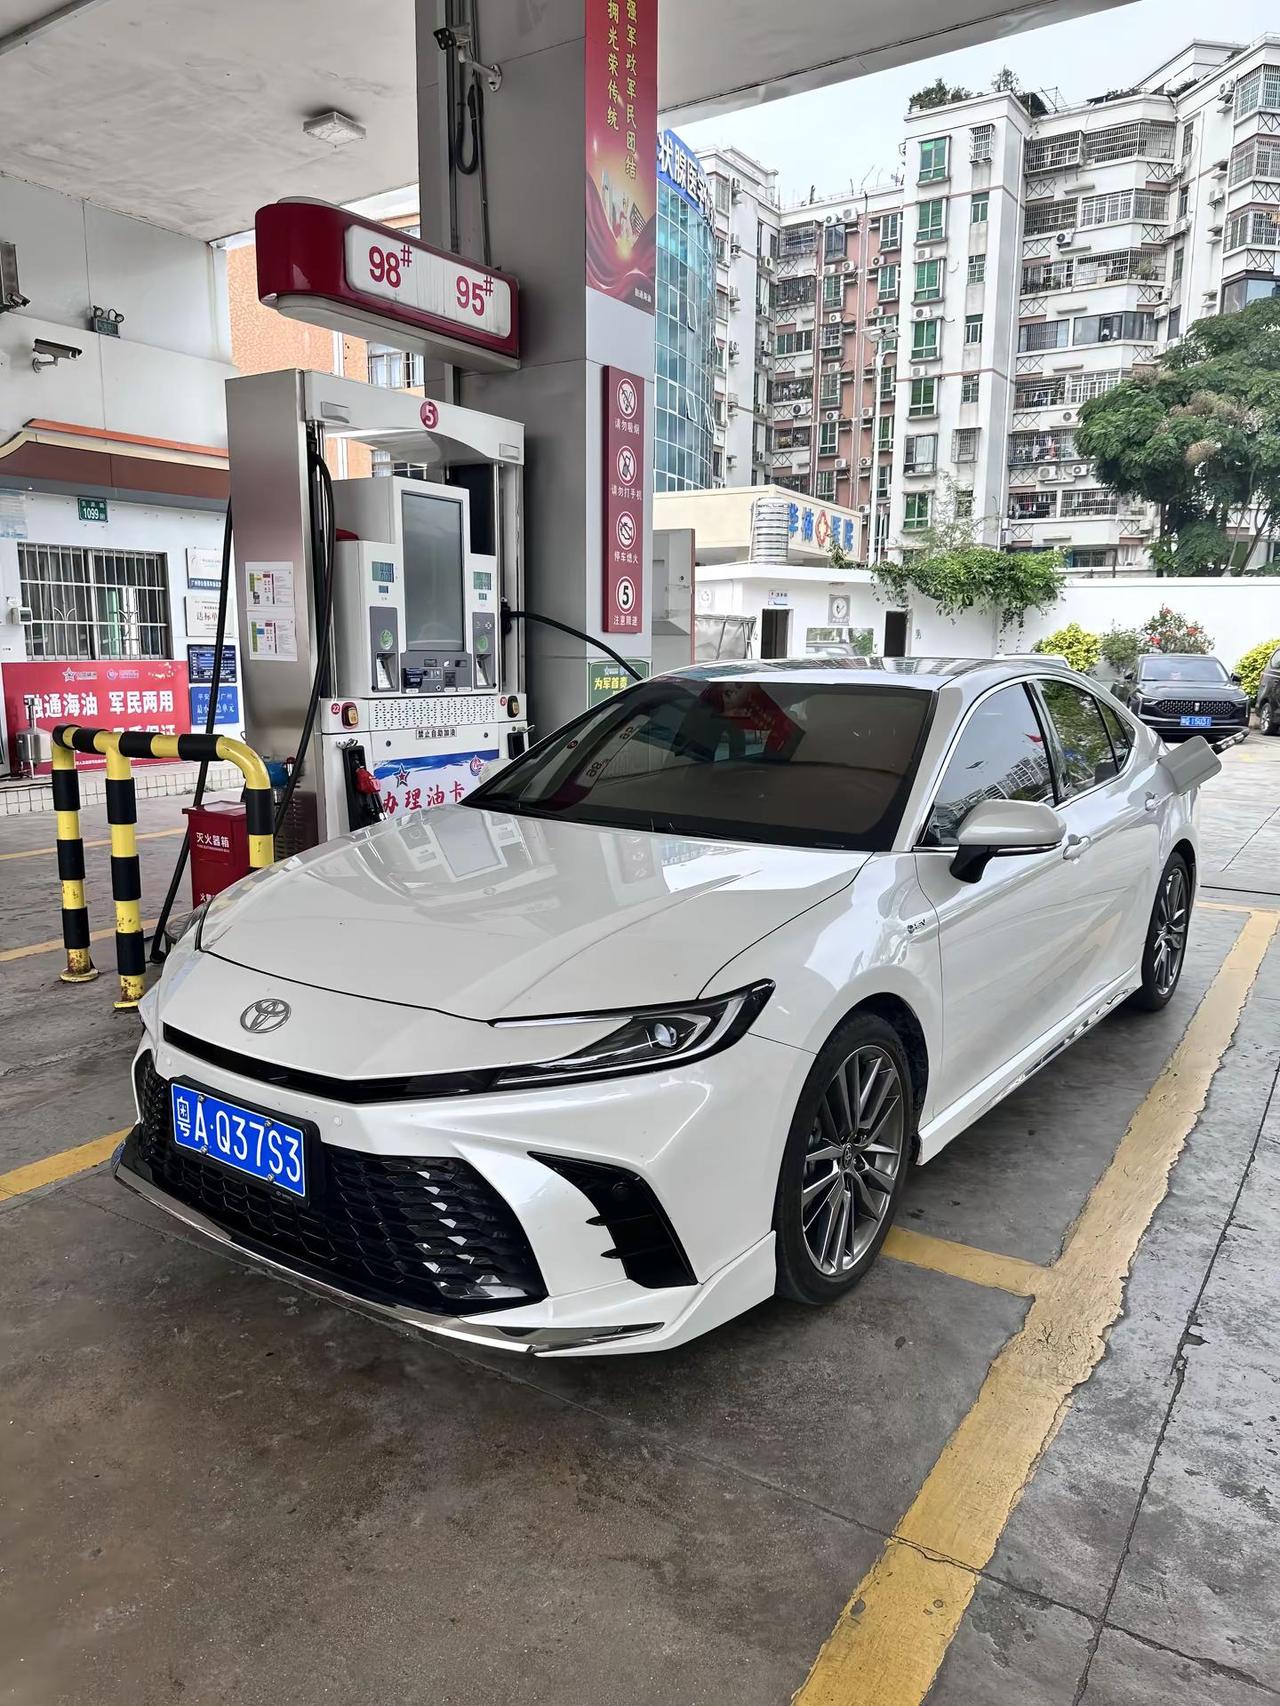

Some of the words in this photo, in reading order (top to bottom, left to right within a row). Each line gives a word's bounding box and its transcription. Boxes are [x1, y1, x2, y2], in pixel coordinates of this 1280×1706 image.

[425, 404, 434, 425] 5
[611, 484, 643, 502] 请勿打手机
[622, 585, 630, 606] 5
[109, 690, 174, 715] 军民两用
[383, 781, 464, 814] 办理油卡
[196, 832, 230, 848] 灭火器箱
